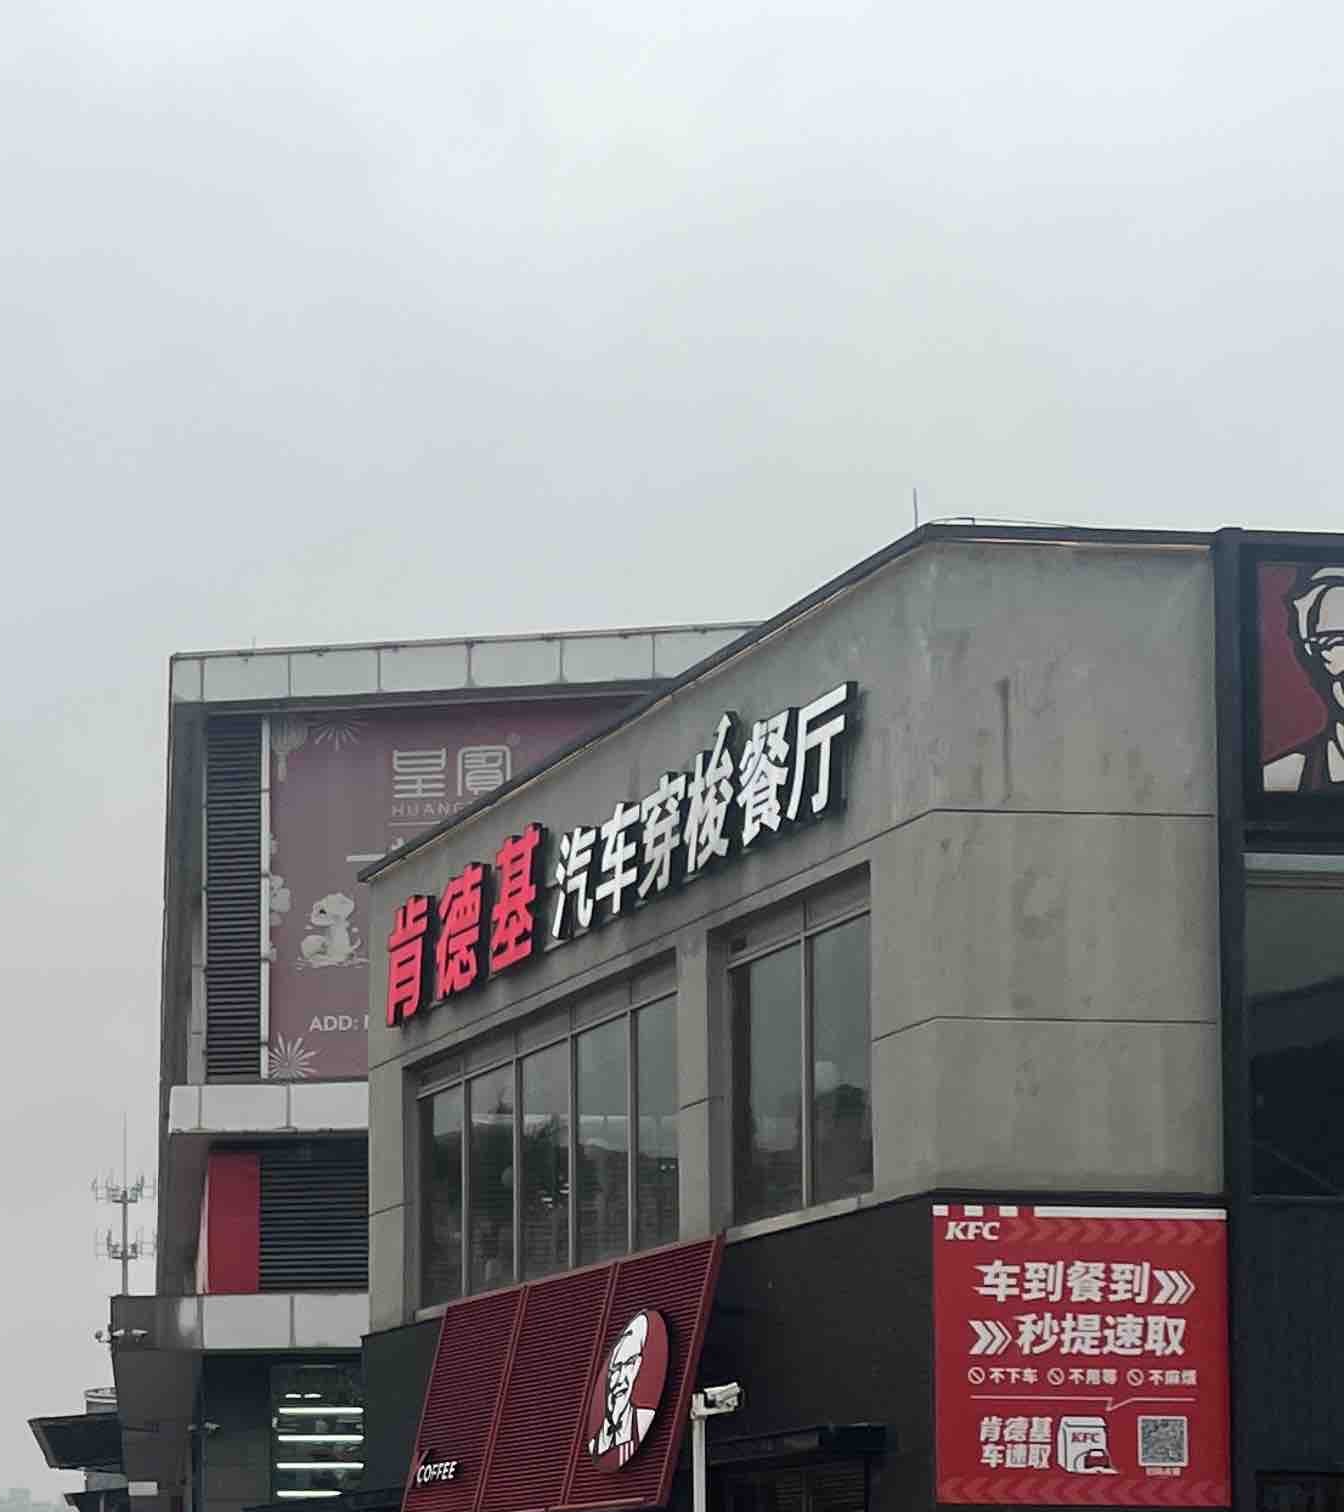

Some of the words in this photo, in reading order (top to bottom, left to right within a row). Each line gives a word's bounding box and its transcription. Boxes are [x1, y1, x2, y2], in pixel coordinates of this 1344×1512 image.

[386, 822, 543, 1025] 肯德基
[551, 683, 852, 940] 汽车穿梭餐厅
[944, 1221, 1000, 1241] KFC
[971, 1259, 1151, 1304] 车到餐到
[1013, 1312, 1186, 1356] 秒提速取
[989, 1368, 1038, 1384] 不下车
[980, 1415, 1053, 1442] 肯德基
[1071, 1431, 1100, 1443] KFC
[417, 1461, 457, 1483] COFFEE
